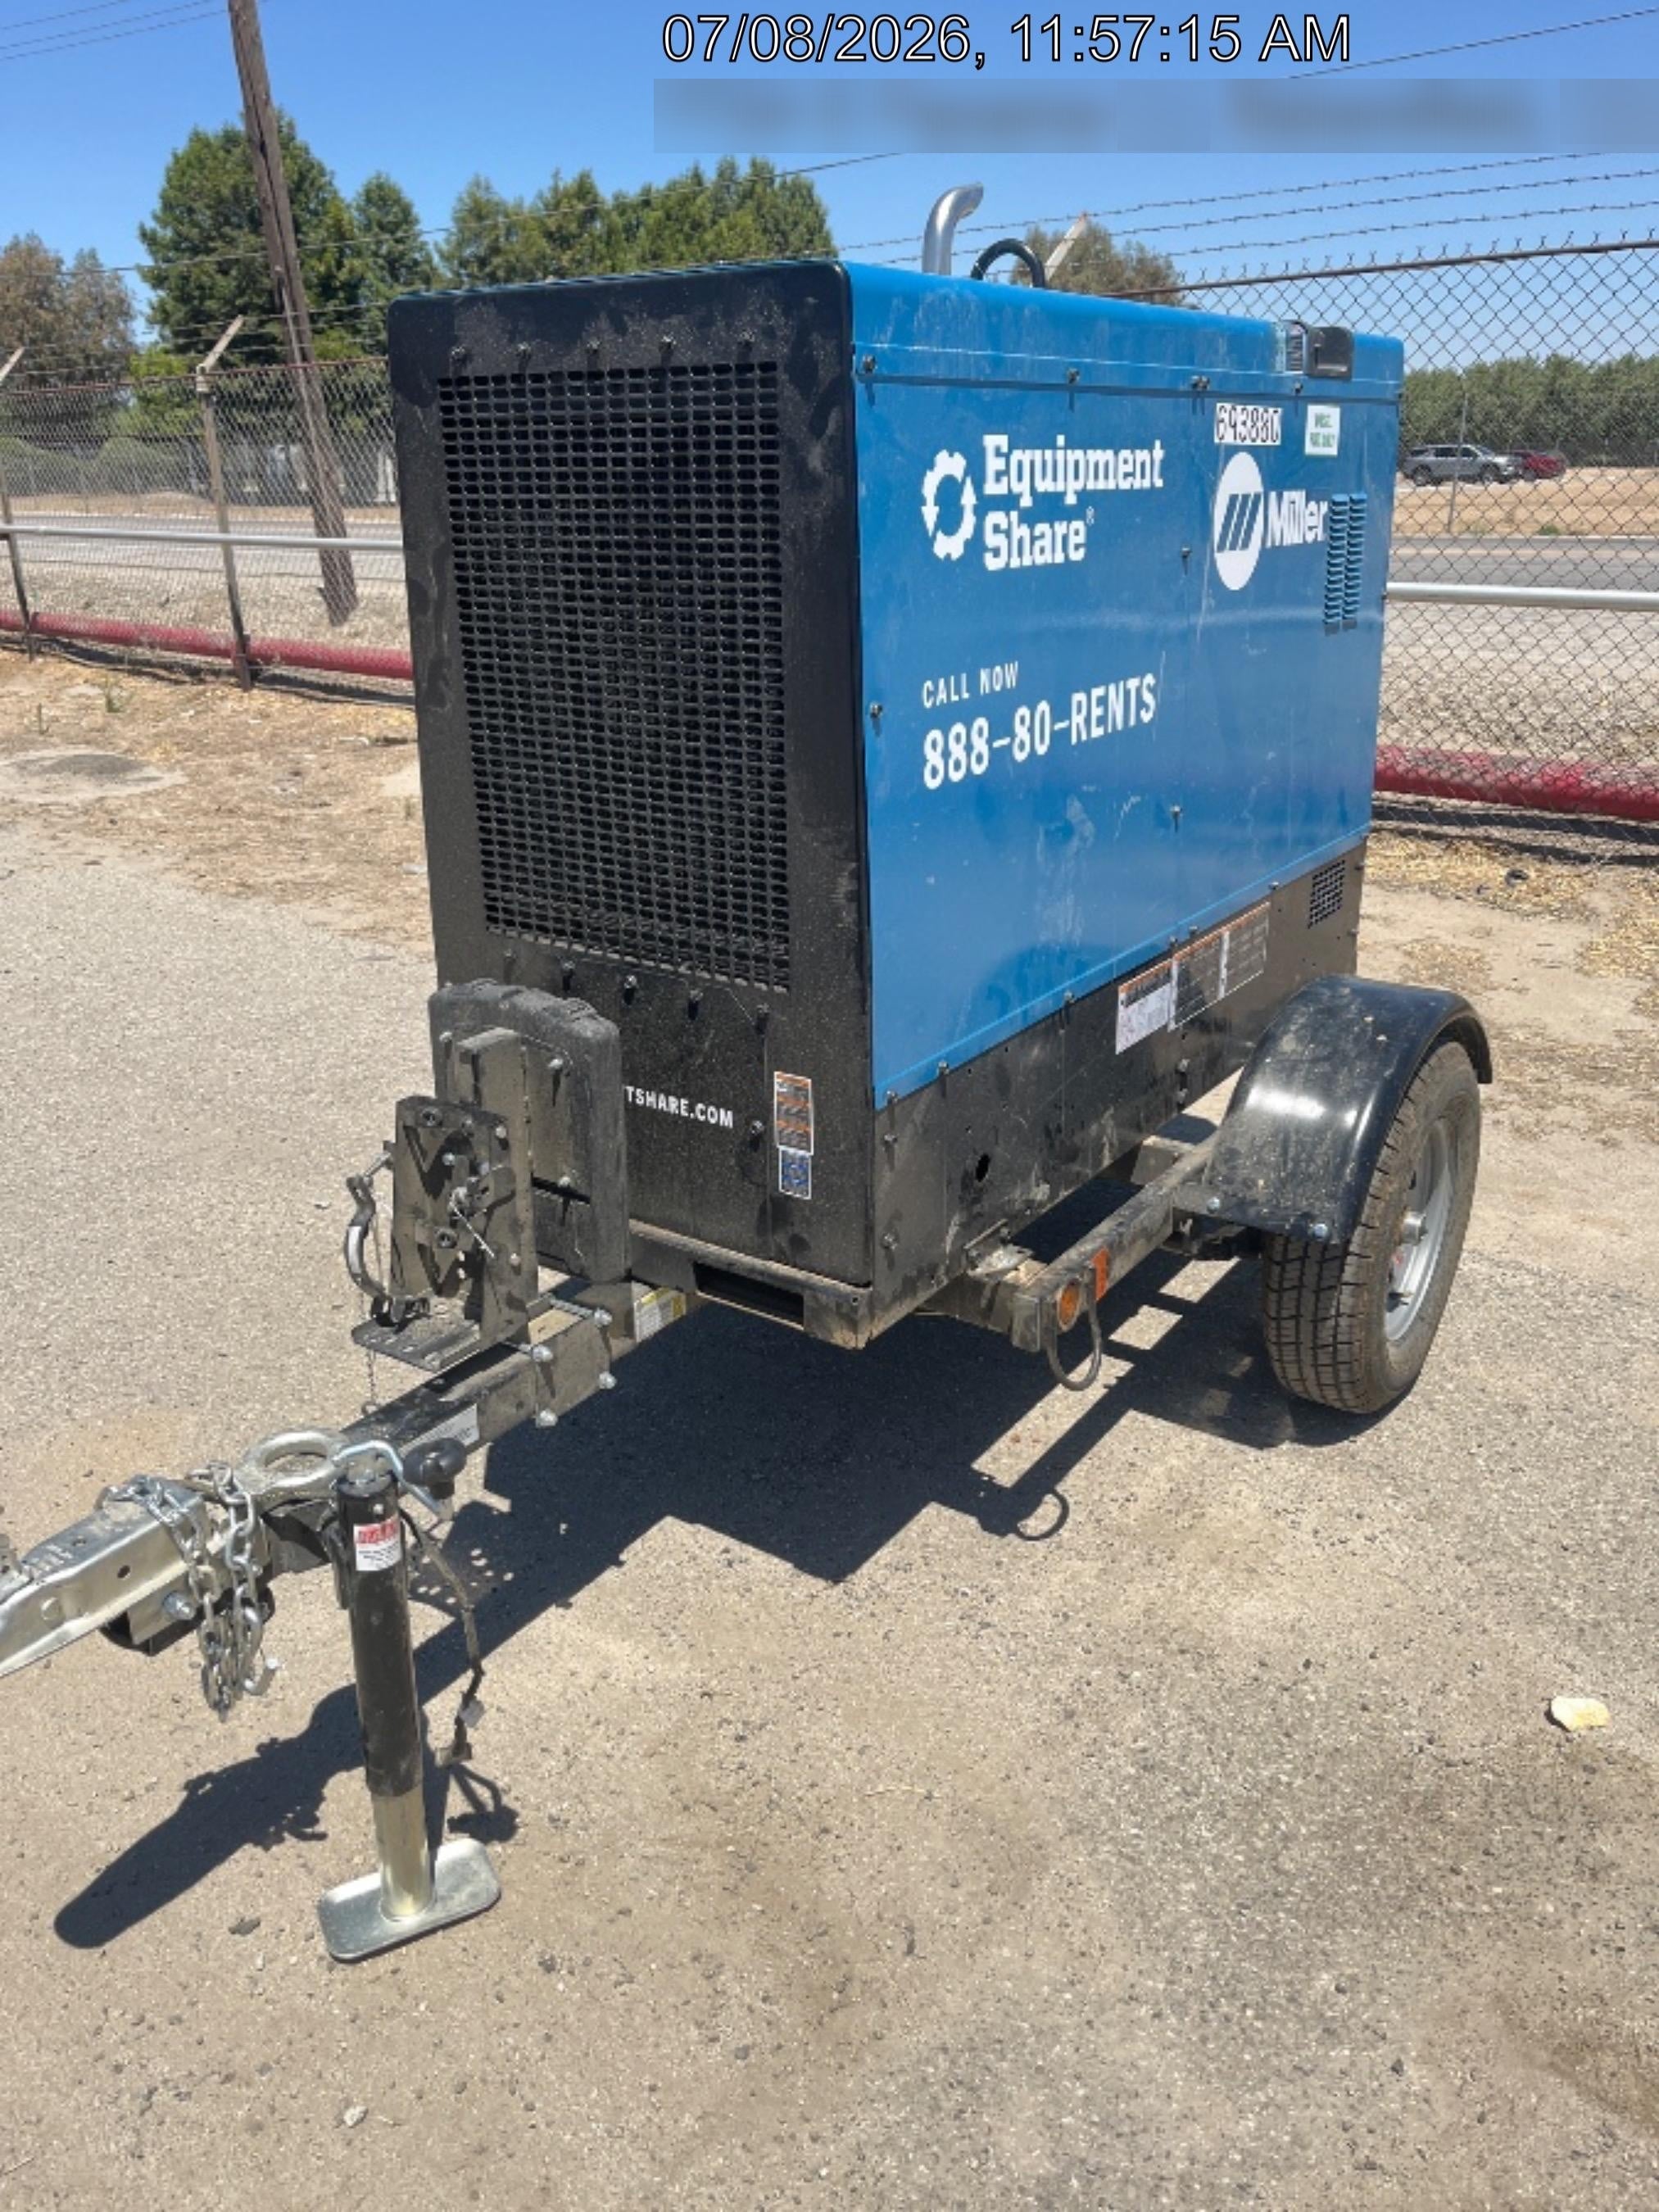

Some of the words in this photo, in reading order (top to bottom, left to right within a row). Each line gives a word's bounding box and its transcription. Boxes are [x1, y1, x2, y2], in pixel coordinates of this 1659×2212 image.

[983, 434, 1164, 507] Equipment
[1266, 489, 1328, 548] Miller
[922, 673, 969, 709] CALL
[980, 660, 1018, 695] NOW
[923, 673, 1156, 790] 888-80-RENTS
